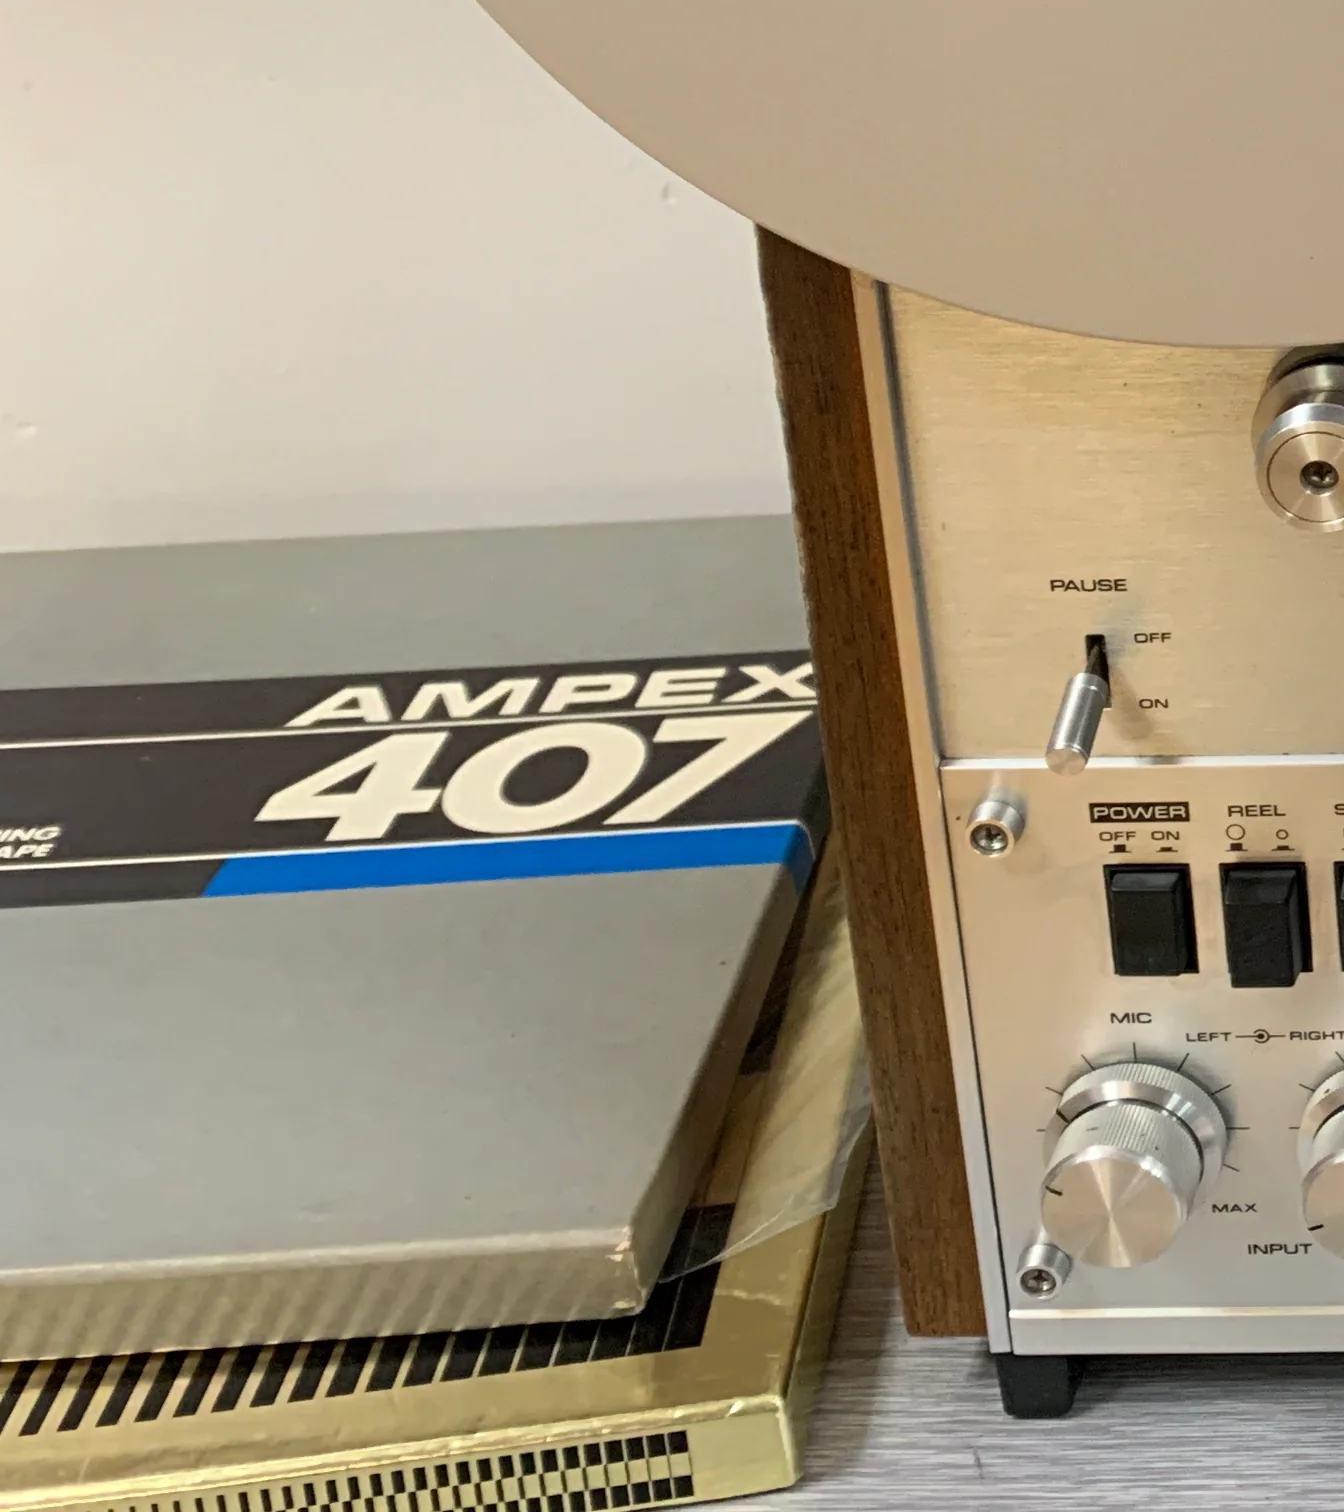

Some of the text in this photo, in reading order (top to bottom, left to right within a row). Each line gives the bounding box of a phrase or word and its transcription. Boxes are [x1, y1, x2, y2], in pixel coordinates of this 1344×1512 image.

[1050, 578, 1128, 593] PAUSE
[1133, 632, 1173, 644] OFF
[282, 661, 817, 729] AMPEX
[1138, 698, 1169, 709] ON
[255, 710, 815, 843] 407
[1093, 805, 1187, 821] POWER
[1227, 804, 1286, 818] REEL
[1099, 830, 1180, 842] OFF ON
[1109, 1011, 1153, 1024] MIC
[1185, 1031, 1232, 1043] LEFT
[1212, 1202, 1258, 1214] MAX
[1247, 1242, 1313, 1256] INPUT
